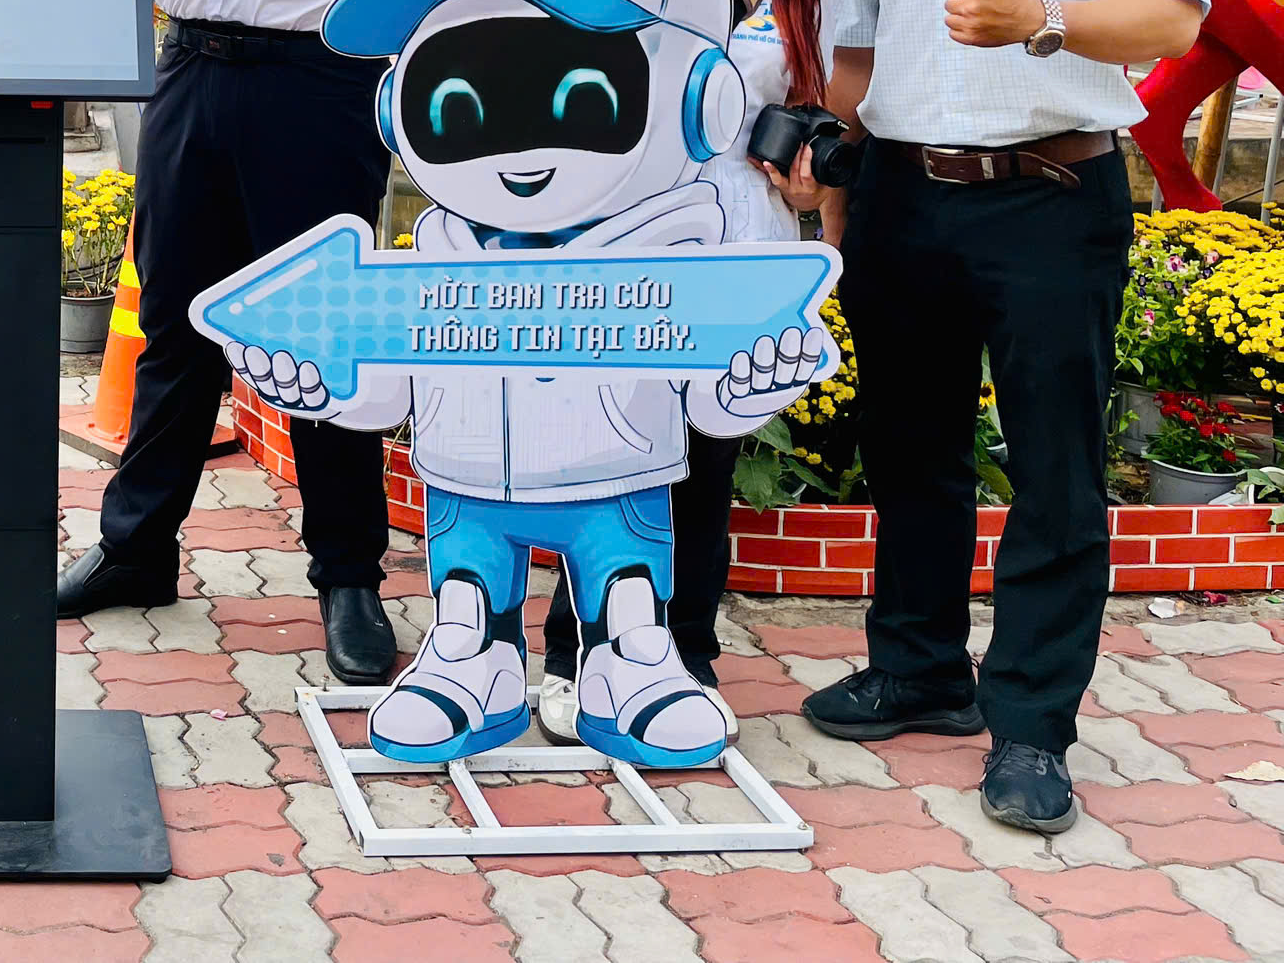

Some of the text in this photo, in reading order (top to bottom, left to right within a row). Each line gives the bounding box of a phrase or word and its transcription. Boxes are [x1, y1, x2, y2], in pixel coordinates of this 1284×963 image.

[419, 275, 480, 309] MỜI
[552, 282, 605, 309] TRA
[614, 275, 672, 309] CỨU
[408, 313, 696, 359] THÔNG TIN TẠI ĐÂY.
